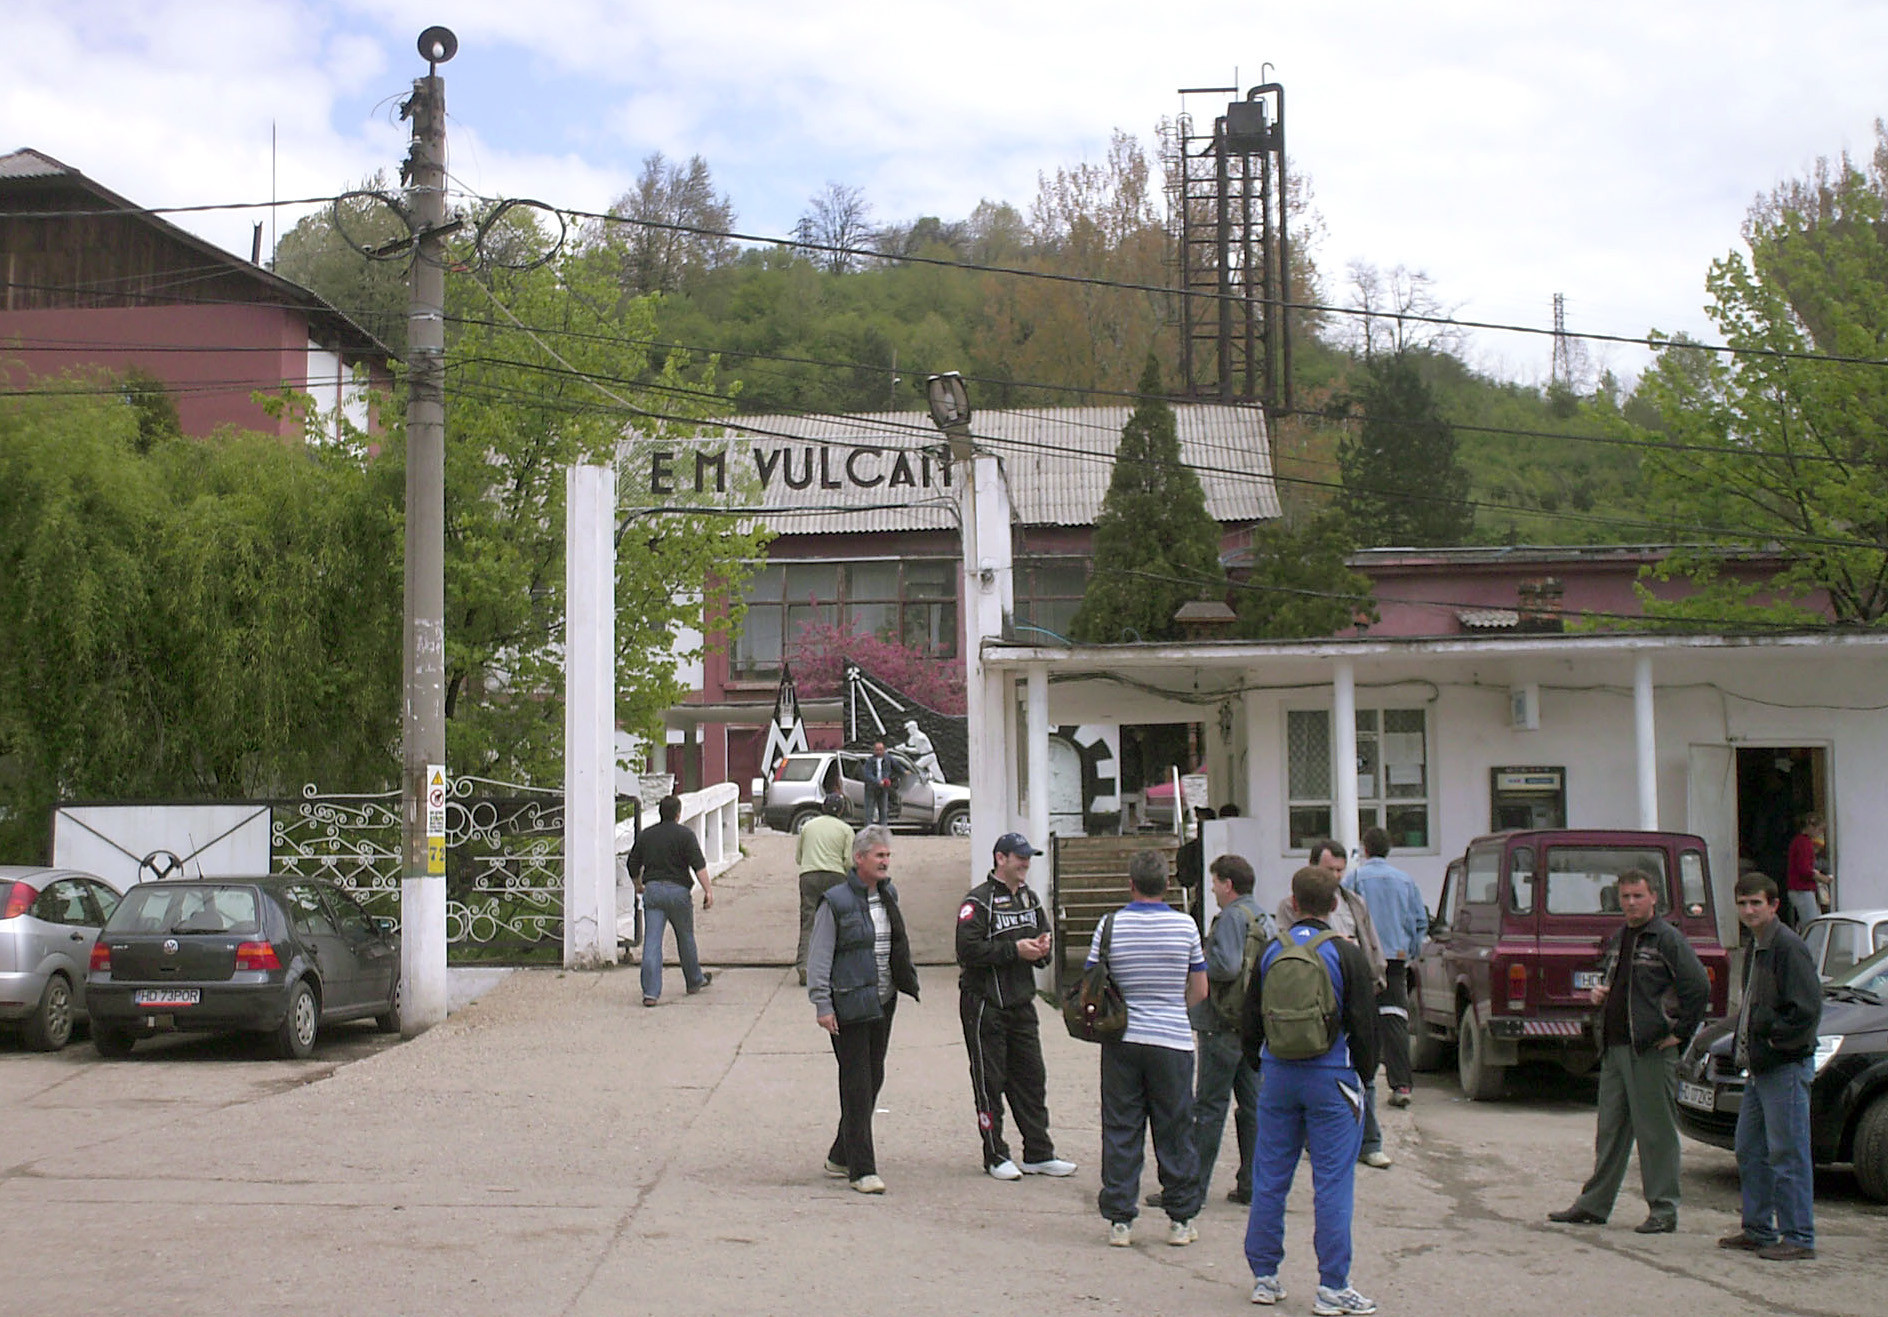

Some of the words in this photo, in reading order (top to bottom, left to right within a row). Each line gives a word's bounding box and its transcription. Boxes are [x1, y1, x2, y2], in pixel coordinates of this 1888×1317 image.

[753, 446, 951, 490] VULCAN
[430, 847, 444, 861] 72
[141, 989, 158, 1001] HD
